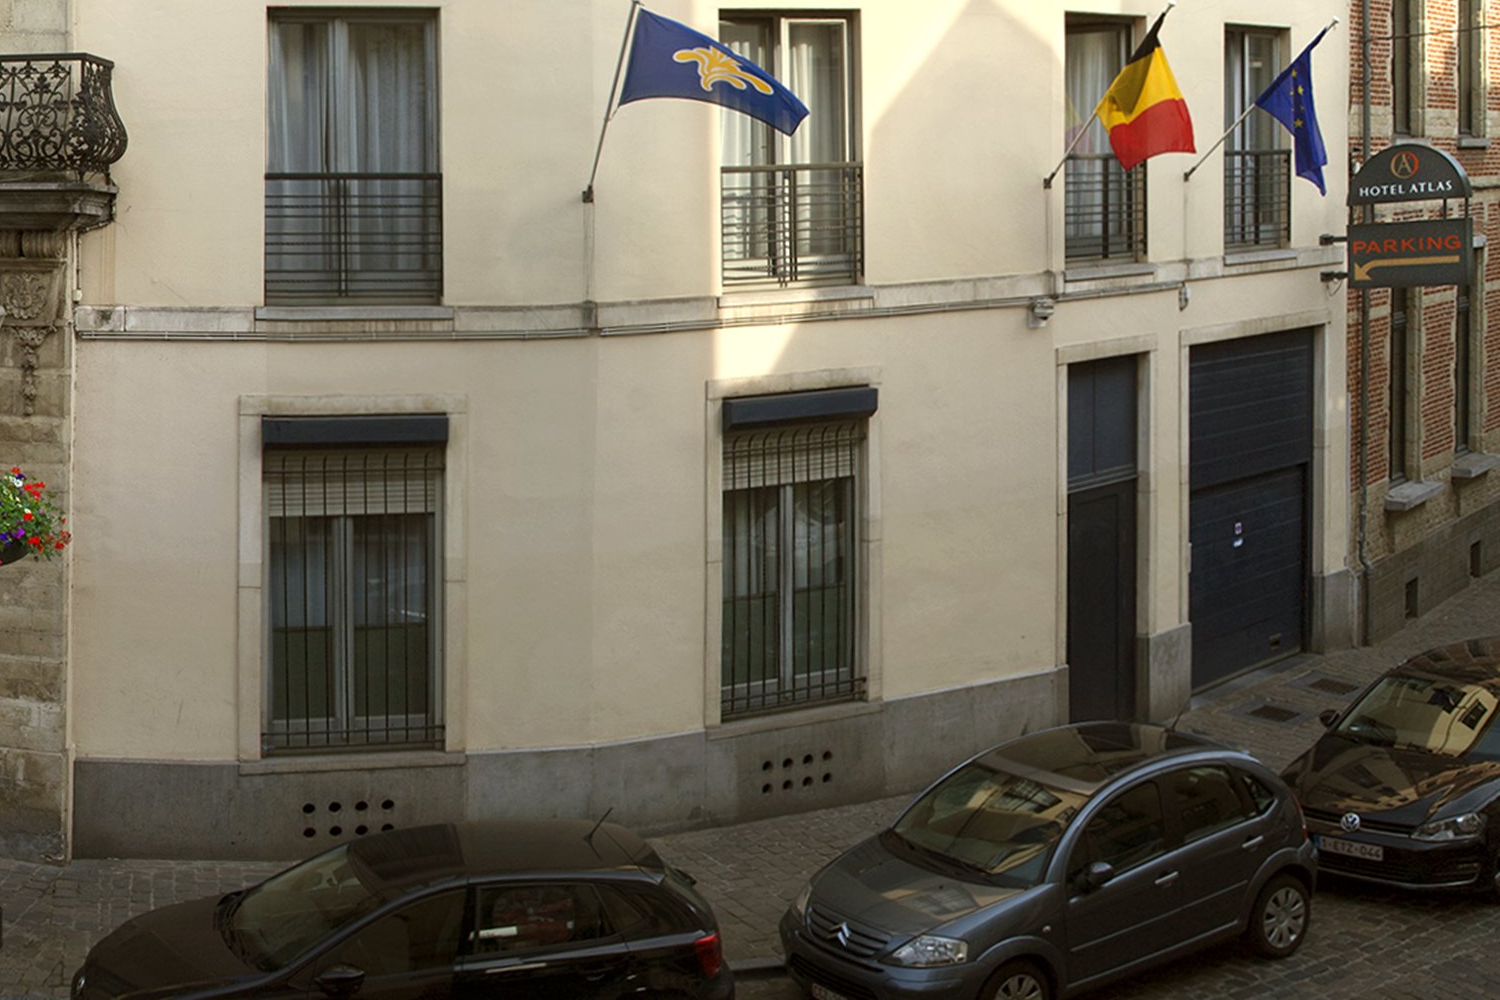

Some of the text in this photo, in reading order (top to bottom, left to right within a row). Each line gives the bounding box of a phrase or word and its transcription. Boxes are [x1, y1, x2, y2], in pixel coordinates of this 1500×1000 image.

[1359, 180, 1452, 197] HOTEL ATLAS
[1352, 235, 1461, 255] PARKING
